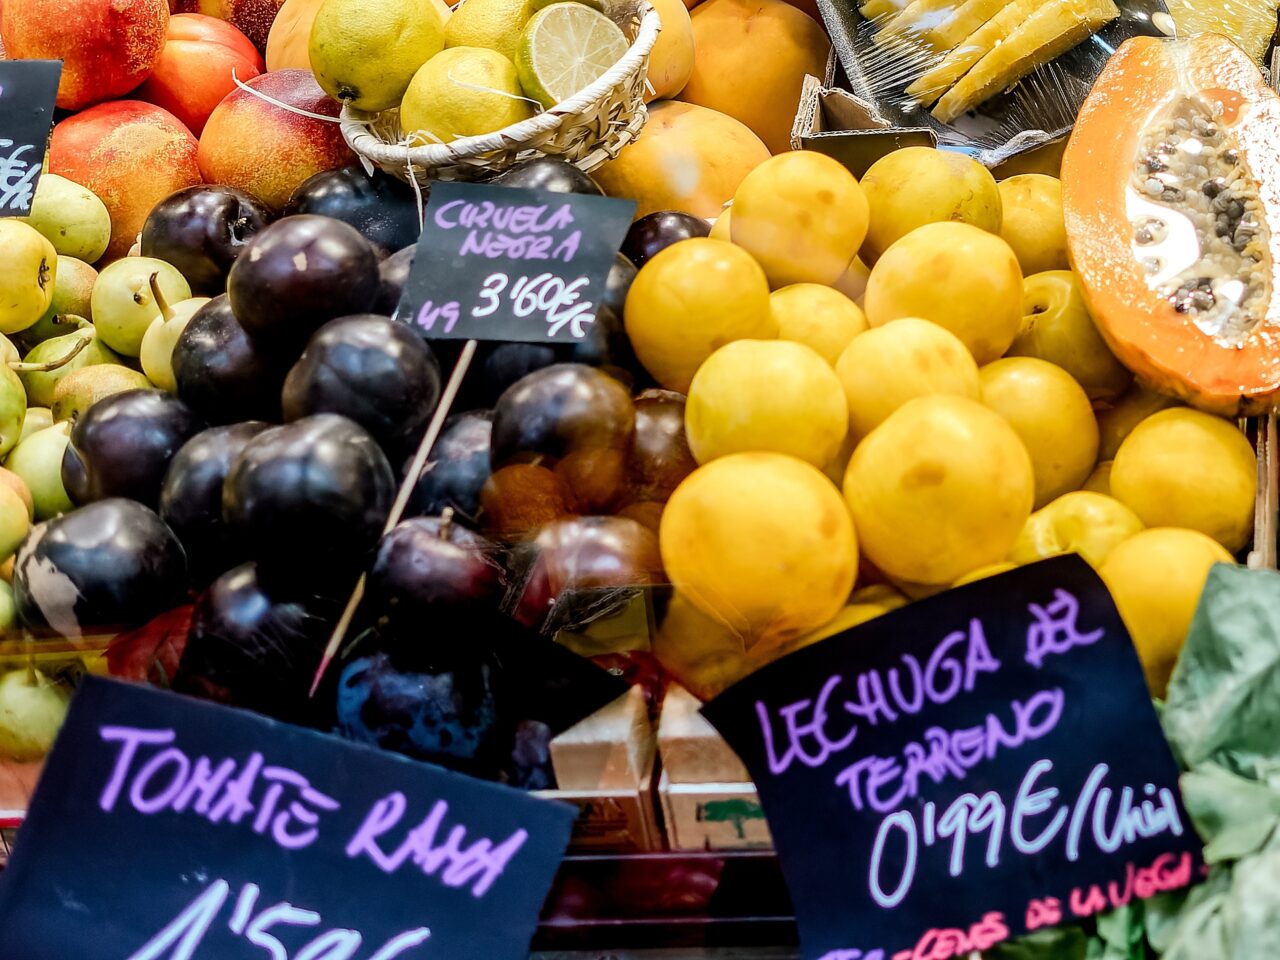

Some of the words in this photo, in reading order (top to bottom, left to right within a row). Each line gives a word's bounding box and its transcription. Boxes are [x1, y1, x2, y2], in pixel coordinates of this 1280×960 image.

[434, 199, 575, 235] CIRUELA
[755, 617, 1001, 776] LECHUGA
[834, 687, 1065, 813] TERRENO
[98, 725, 341, 849] TOMATE
[345, 790, 529, 899] RAMA
